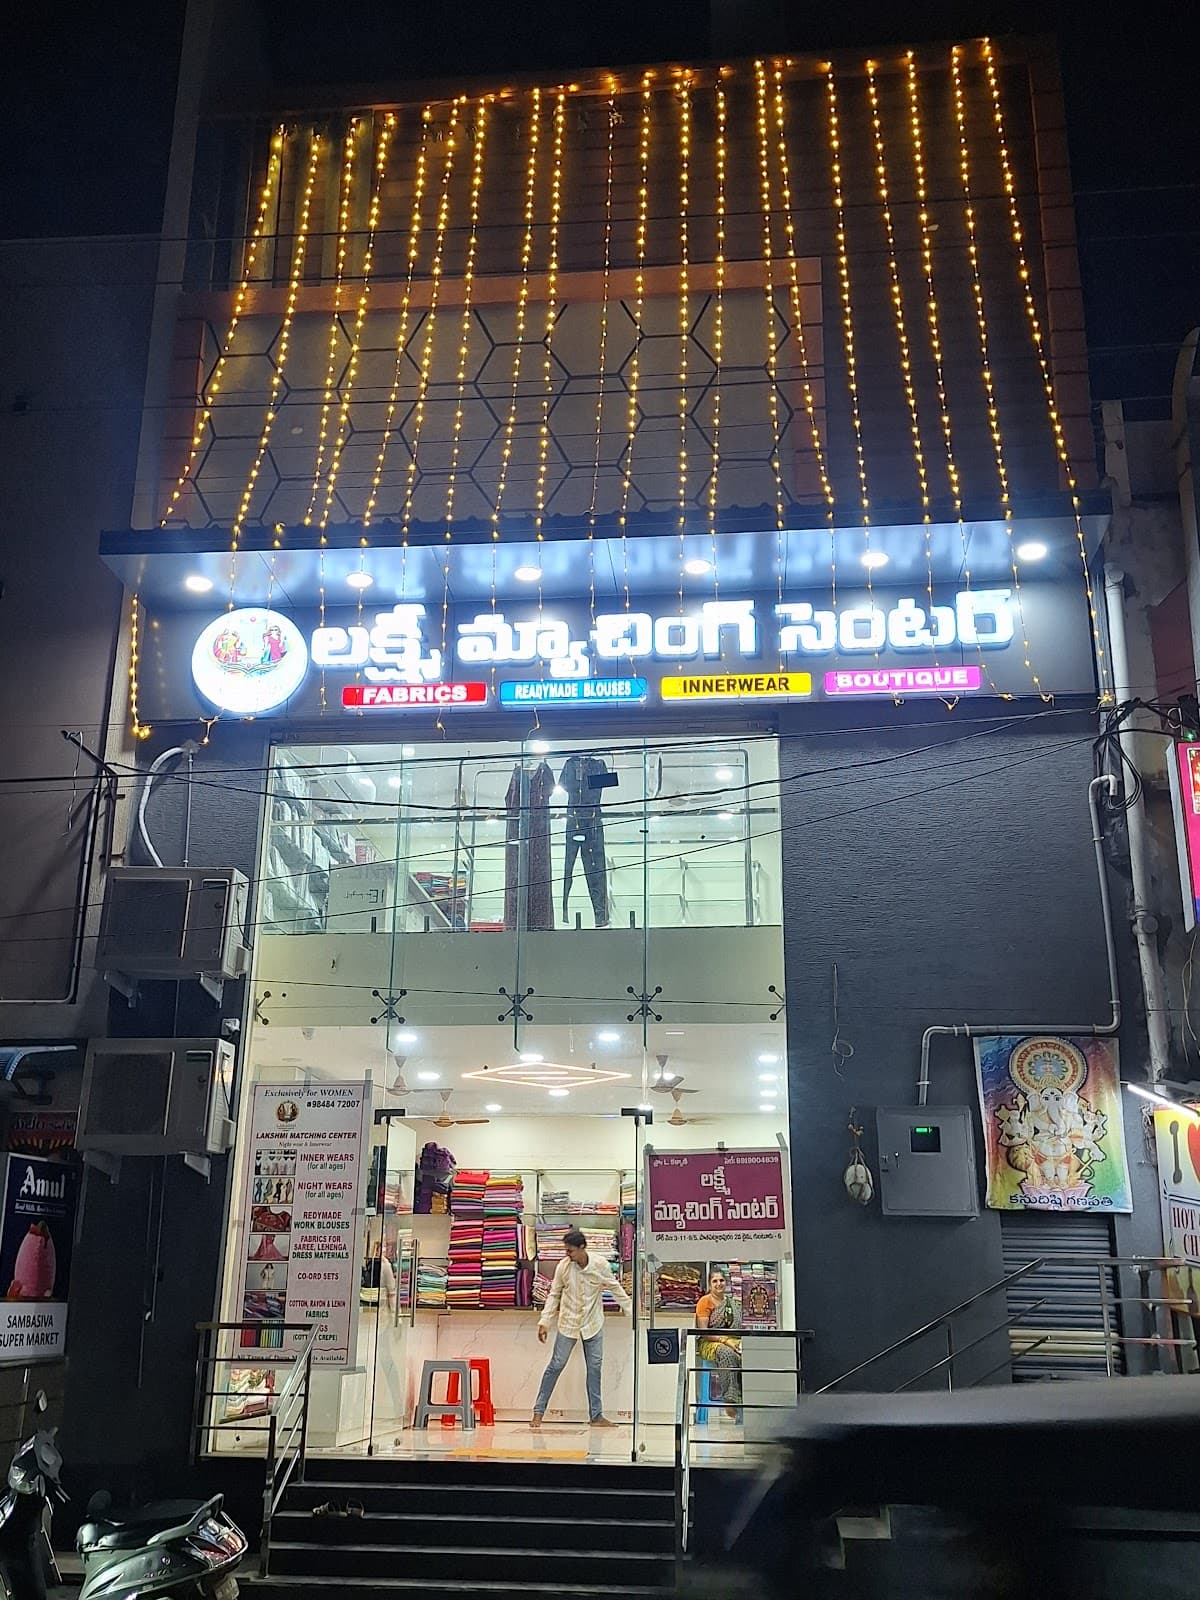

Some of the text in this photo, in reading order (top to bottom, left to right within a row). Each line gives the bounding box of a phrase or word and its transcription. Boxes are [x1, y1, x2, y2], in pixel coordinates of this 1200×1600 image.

[457, 600, 756, 678] మ్యాచింగ్
[775, 588, 1015, 652] సెంటర్
[683, 677, 790, 693] INNERWEAR
[837, 670, 968, 687] BOUTIQUE
[363, 684, 467, 704] FABRICS
[515, 681, 632, 699] READYMADE BLOUSES
[264, 1089, 305, 1098] Exclusively
[328, 1162, 346, 1171] ages)
[20, 1165, 66, 1199] Amul
[297, 1182, 353, 1190] NIGHT WEARS
[326, 1191, 344, 1199] ages)
[1066, 1195, 1113, 1207] గణపతి
[303, 1211, 342, 1219] REDYMADE
[654, 1195, 779, 1229] మ్యాచింగ్ సెంటర్
[1172, 1207, 1196, 1231] HOT
[294, 1221, 350, 1229] WORK BLOUSES
[300, 1235, 327, 1243] FABRICS
[7, 1314, 54, 1329] SAMBASIVA
[26, 1332, 60, 1346] MARKET
